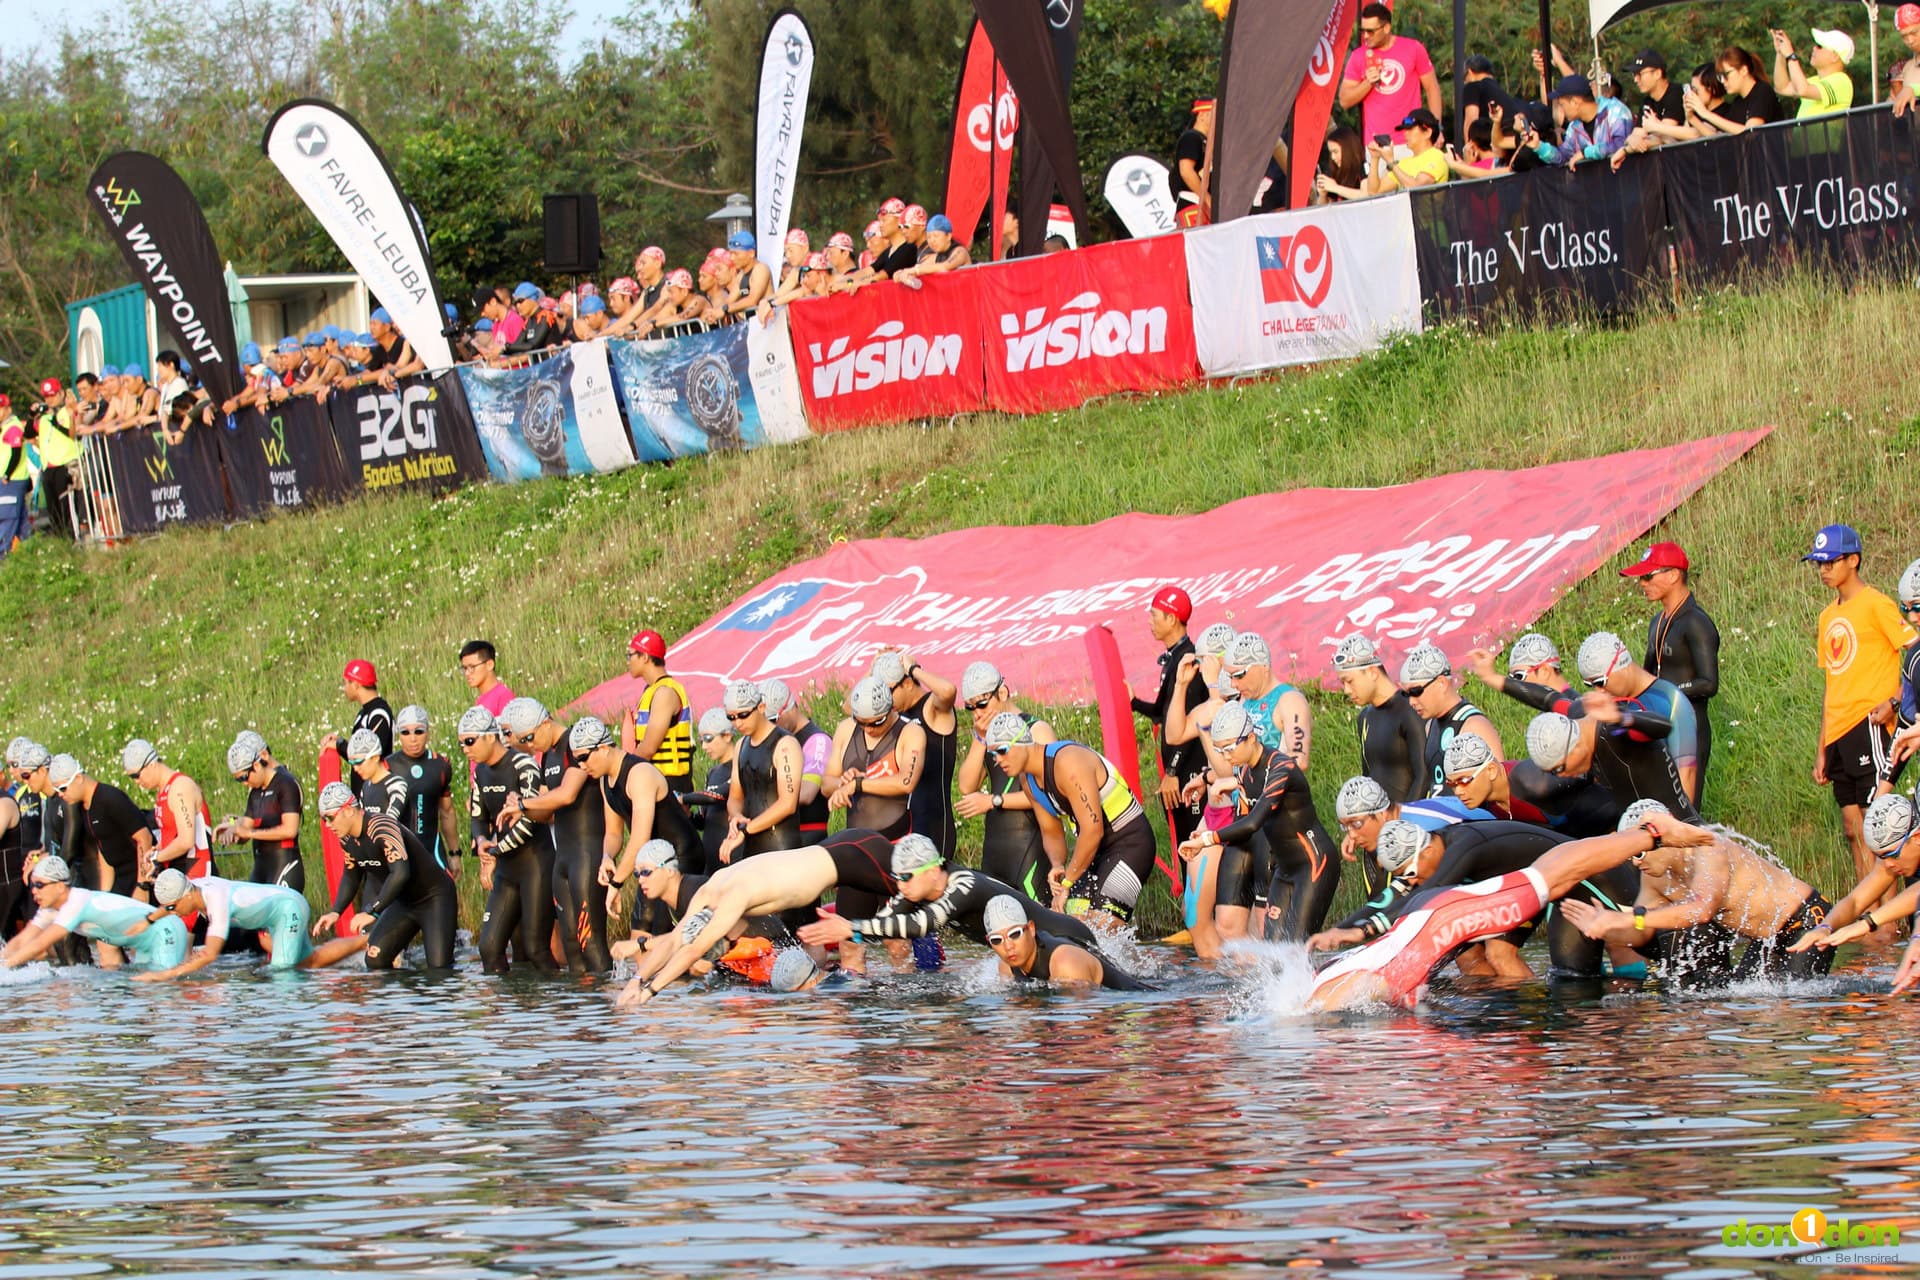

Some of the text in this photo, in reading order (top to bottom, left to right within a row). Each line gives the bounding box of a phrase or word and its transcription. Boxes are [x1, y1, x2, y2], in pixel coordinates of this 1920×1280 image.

[319, 158, 428, 304] FAVRE-LEUBA
[1449, 222, 1619, 288] The V-Class.
[1713, 176, 1909, 246] The V-Class.
[125, 222, 223, 364] WAYPOINT
